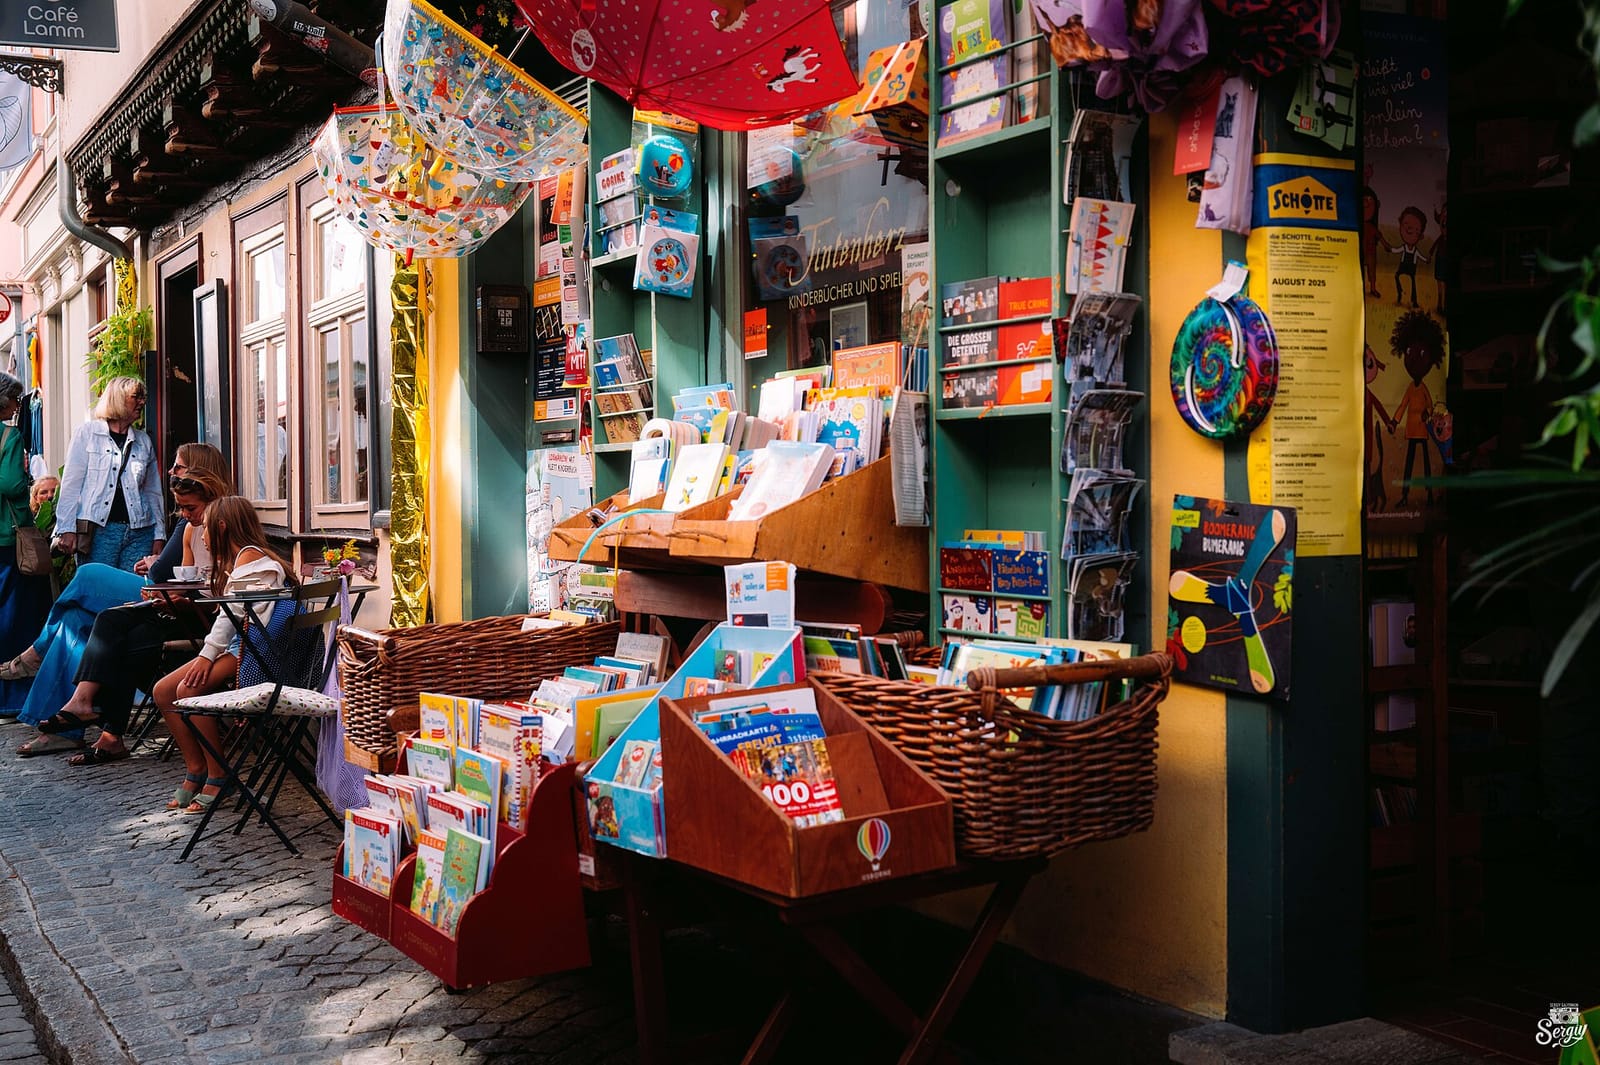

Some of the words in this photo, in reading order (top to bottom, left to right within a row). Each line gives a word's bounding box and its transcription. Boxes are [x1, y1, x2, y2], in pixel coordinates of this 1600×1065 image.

[27, 5, 79, 23] Café
[23, 20, 85, 39] Lamm
[1273, 188, 1334, 213] SCHOTTE
[1271, 278, 1306, 287] AUGUST
[1307, 279, 1327, 287] 2025
[788, 283, 854, 311] KINDERBÜCHER
[854, 277, 879, 296] UND
[1009, 300, 1027, 311] TRUE
[1027, 298, 1049, 310] CRIME
[947, 335, 960, 347] DIE
[960, 330, 993, 346] GROSSEN
[951, 342, 989, 358] DETEKTIVE
[1202, 520, 1257, 540] BOOMERANG
[1201, 536, 1246, 557] BUMERANG
[710, 725, 769, 744] AHRRADKARTE
[762, 781, 810, 806] 100
